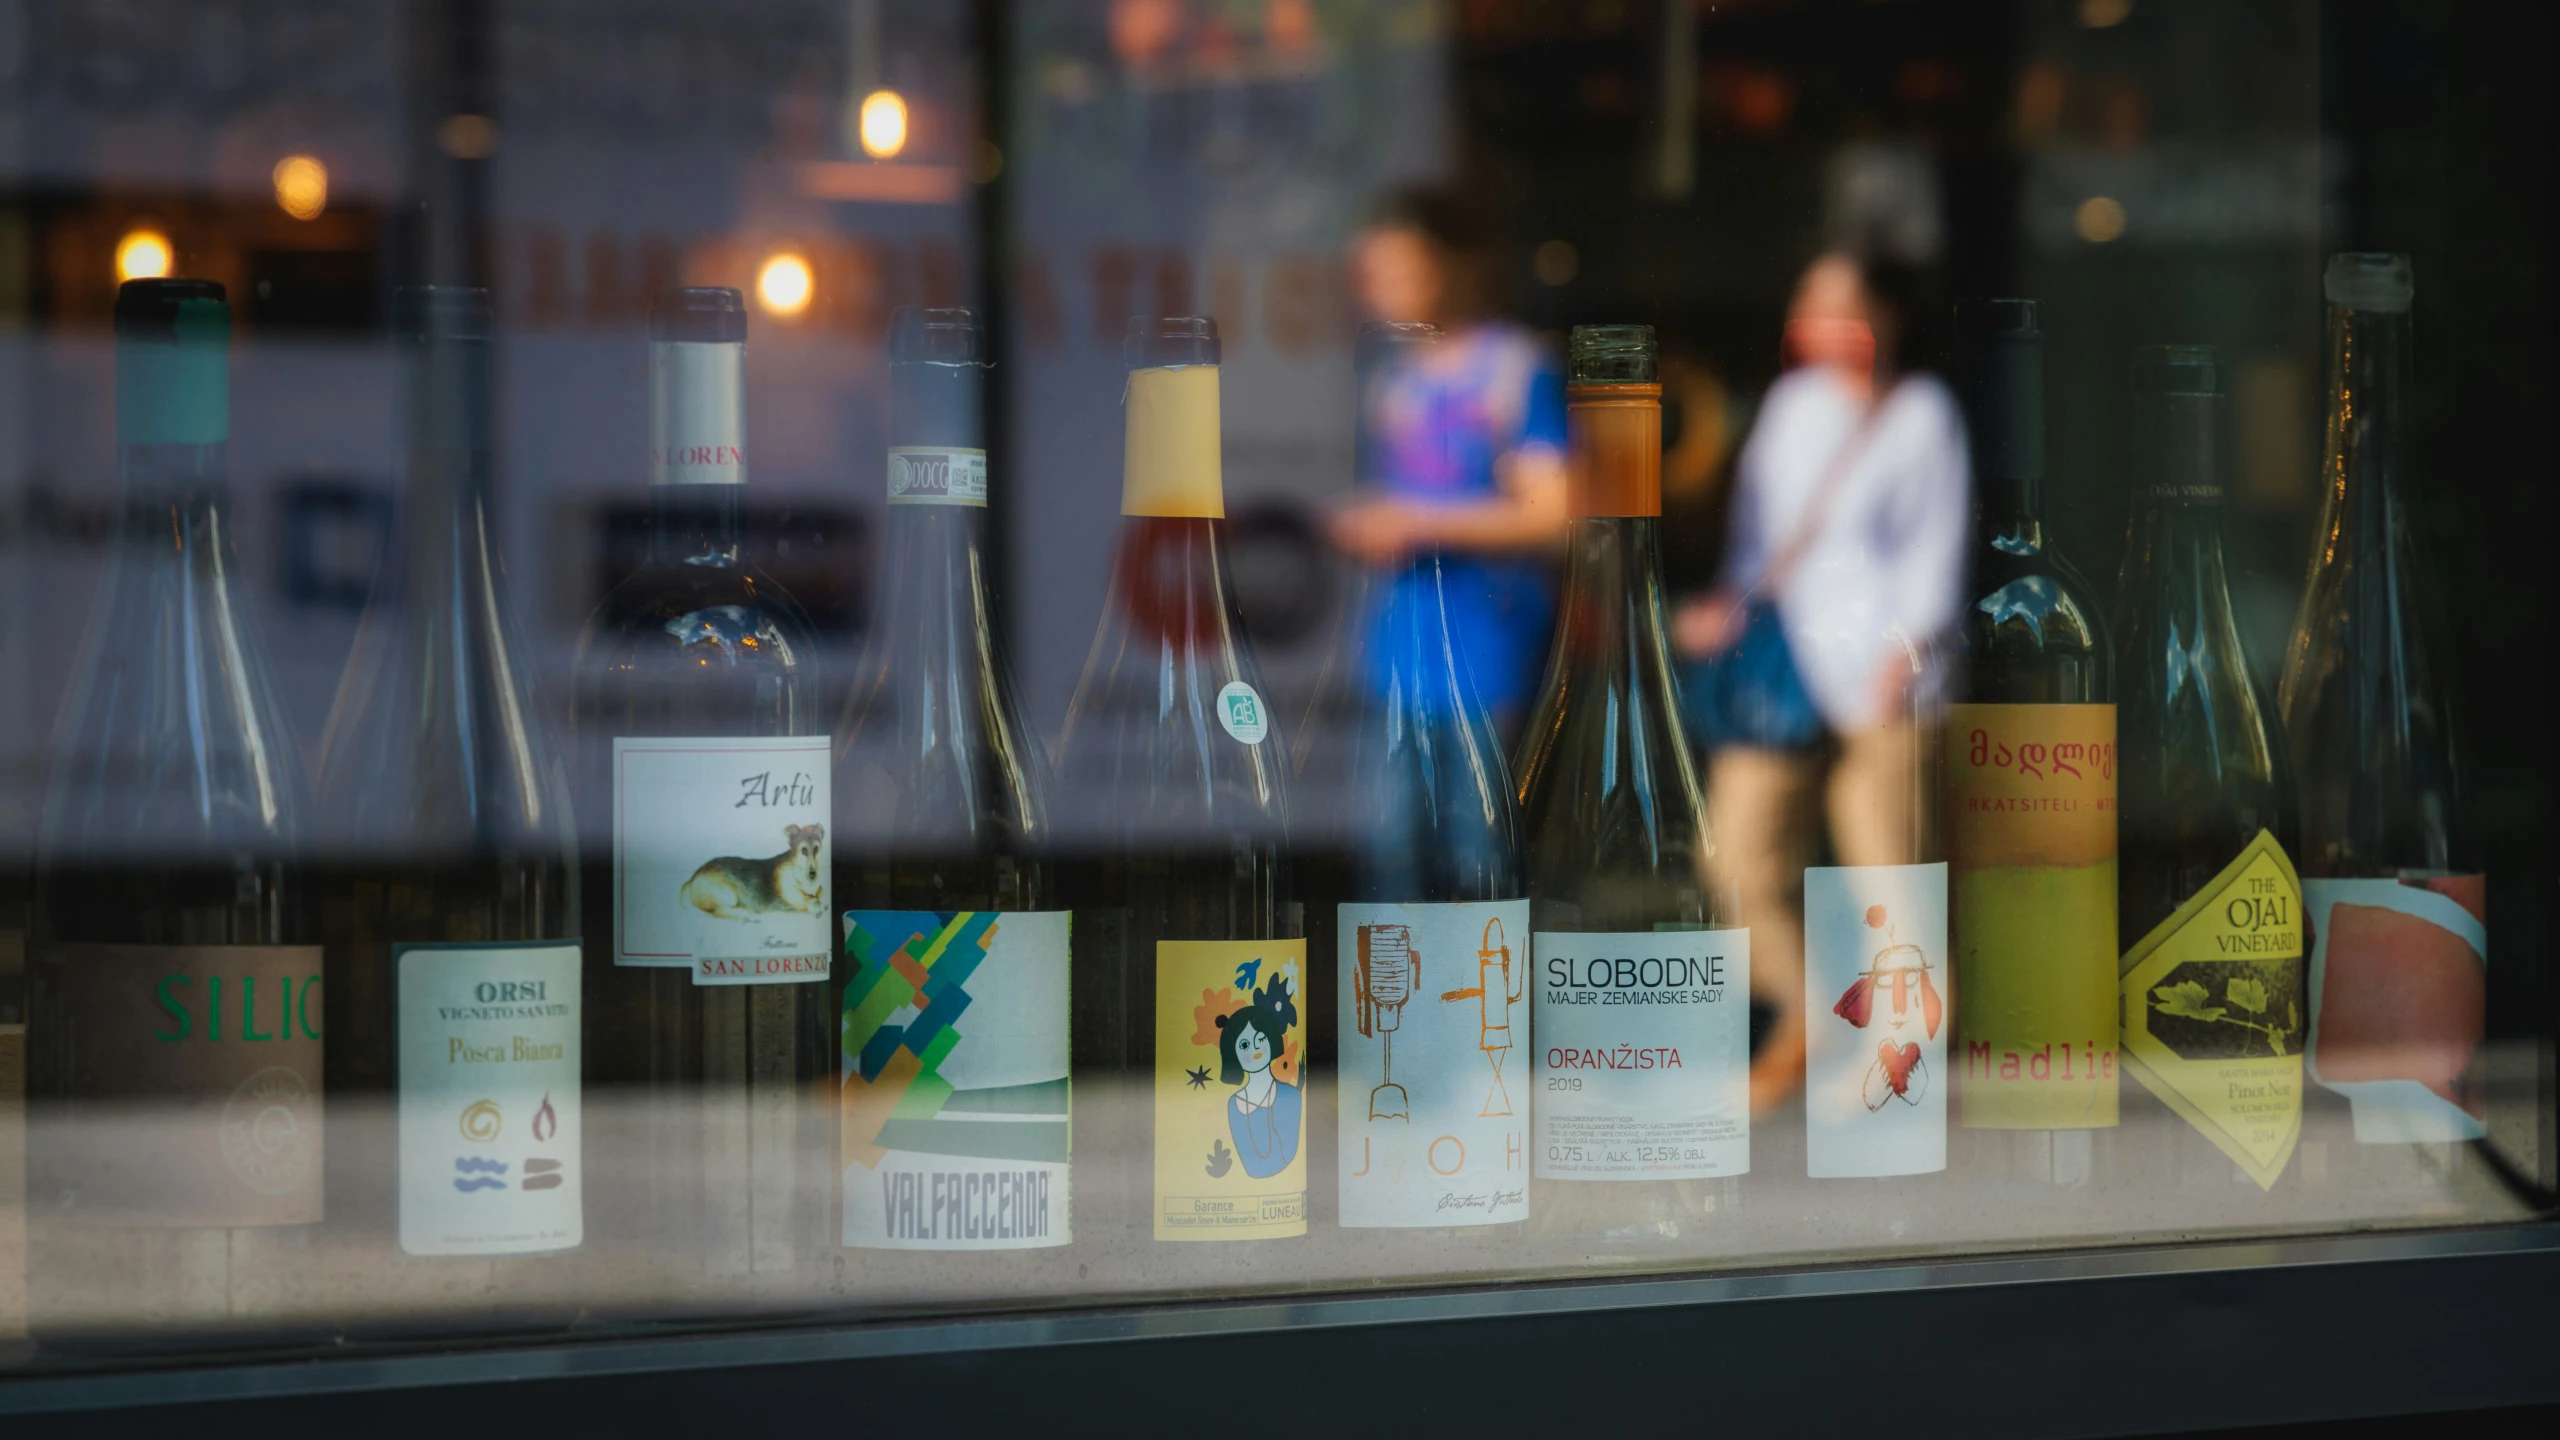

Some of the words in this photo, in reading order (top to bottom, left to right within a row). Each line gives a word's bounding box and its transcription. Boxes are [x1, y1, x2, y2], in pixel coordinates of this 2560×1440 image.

[912, 462, 949, 489] DOCG
[1969, 729, 2117, 781] მადლიე
[734, 771, 814, 809] Artù
[1968, 798, 2077, 812] RKATSITELI
[2247, 877, 2277, 894] THE
[2226, 896, 2288, 932] OJAI
[2216, 932, 2297, 954] VINEYARD
[701, 957, 745, 976] SAN
[755, 955, 829, 974] LORENZO
[1547, 956, 1725, 989] SLOBODNE
[474, 980, 547, 1004] ORSI
[1547, 990, 1599, 1005] MAJER
[1602, 990, 1689, 1005] ZEMIANSKE
[1691, 989, 1724, 1004] SADY
[437, 1006, 515, 1022] VIGNETO
[517, 1005, 544, 1019] SAN
[448, 1036, 506, 1064] Posca
[512, 1035, 564, 1062] Bianca
[1547, 1042, 1683, 1070] ORANŽISTA
[1968, 1039, 2118, 1081] Madlie
[1547, 1077, 1582, 1092] 2019
[2228, 1082, 2265, 1100] Pinot
[1548, 1146, 1583, 1162] 0,75
[1587, 1151, 1595, 1162] L
[1606, 1151, 1632, 1162] ALK.
[1636, 1146, 1681, 1164] 12,5%
[1684, 1149, 1706, 1160] OBJ.
[882, 1170, 1049, 1240] VALFACCENDA
[1193, 1199, 1234, 1213] Garance
[1262, 1204, 1301, 1220] LUNEAU
